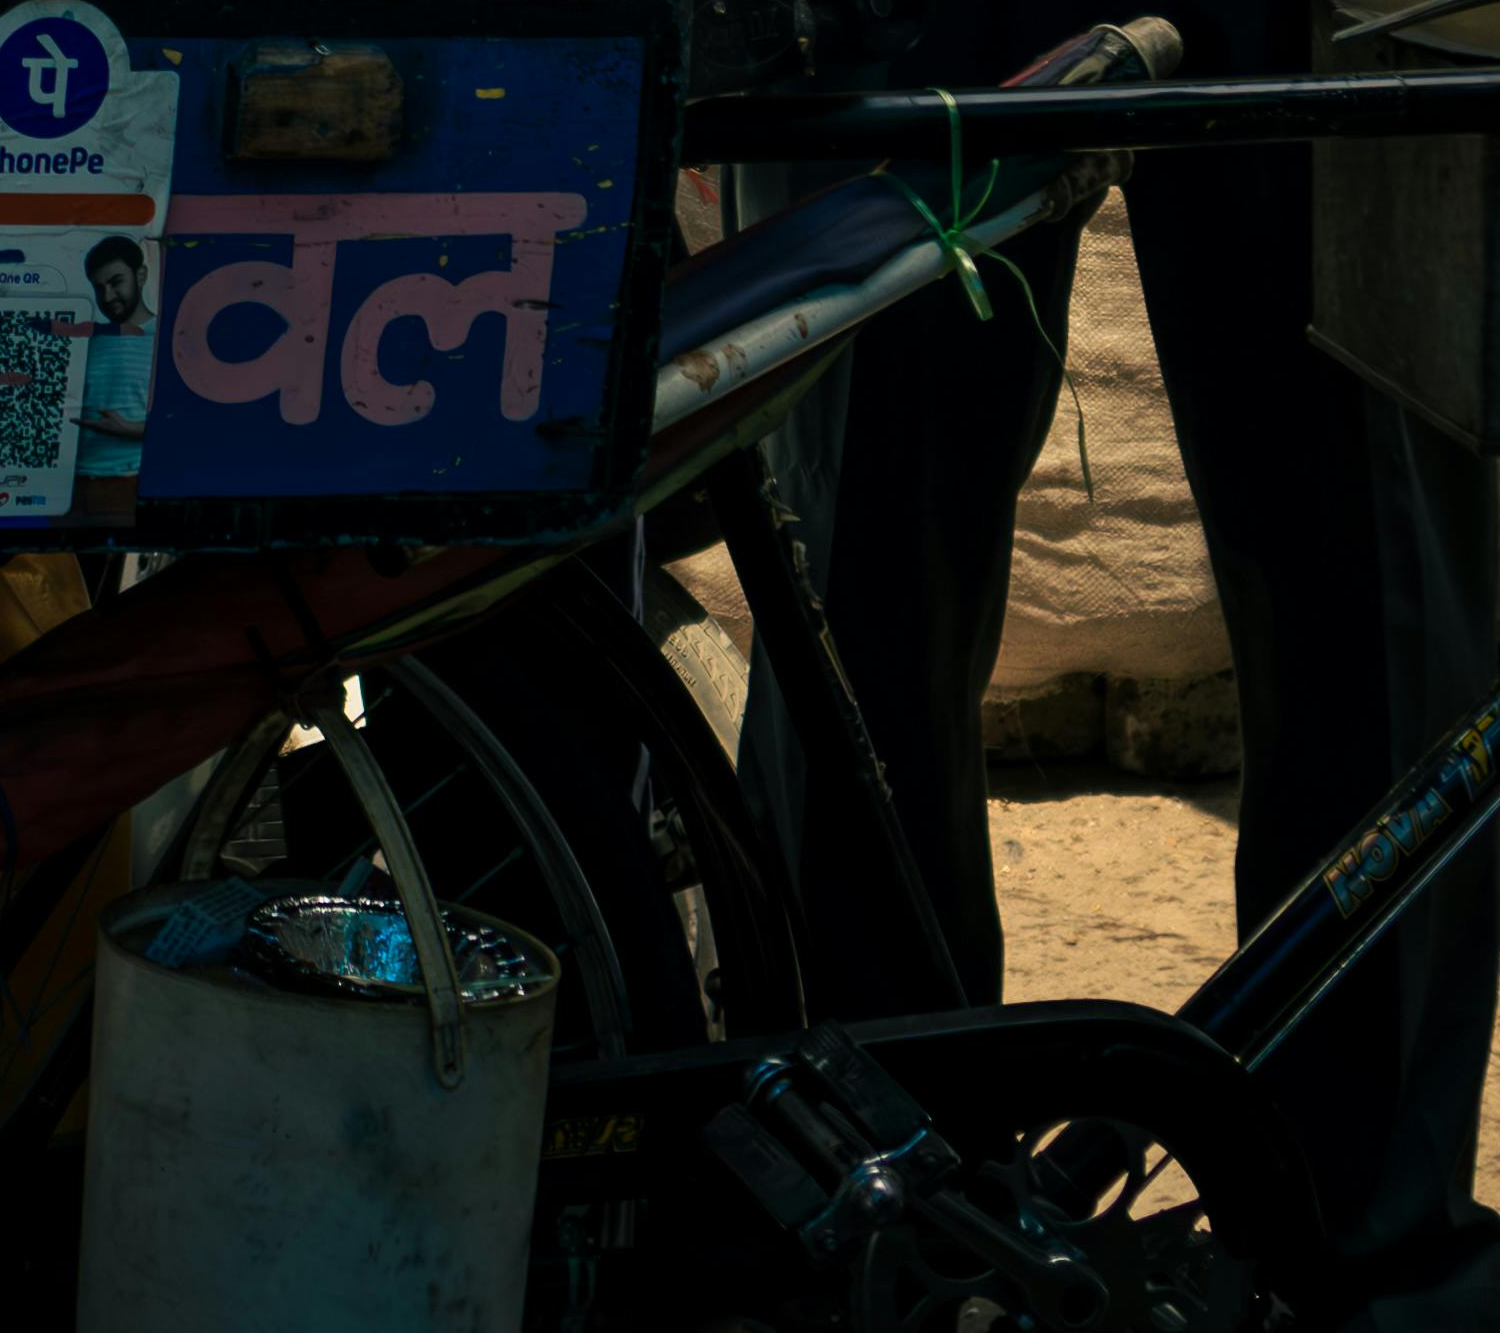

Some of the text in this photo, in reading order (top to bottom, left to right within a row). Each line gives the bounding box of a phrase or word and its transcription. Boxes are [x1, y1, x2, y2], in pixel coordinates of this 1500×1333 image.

[0, 273, 21, 284] One
[23, 273, 40, 284] QR
[160, 193, 588, 426] वल
[1323, 786, 1455, 920] NOVA
